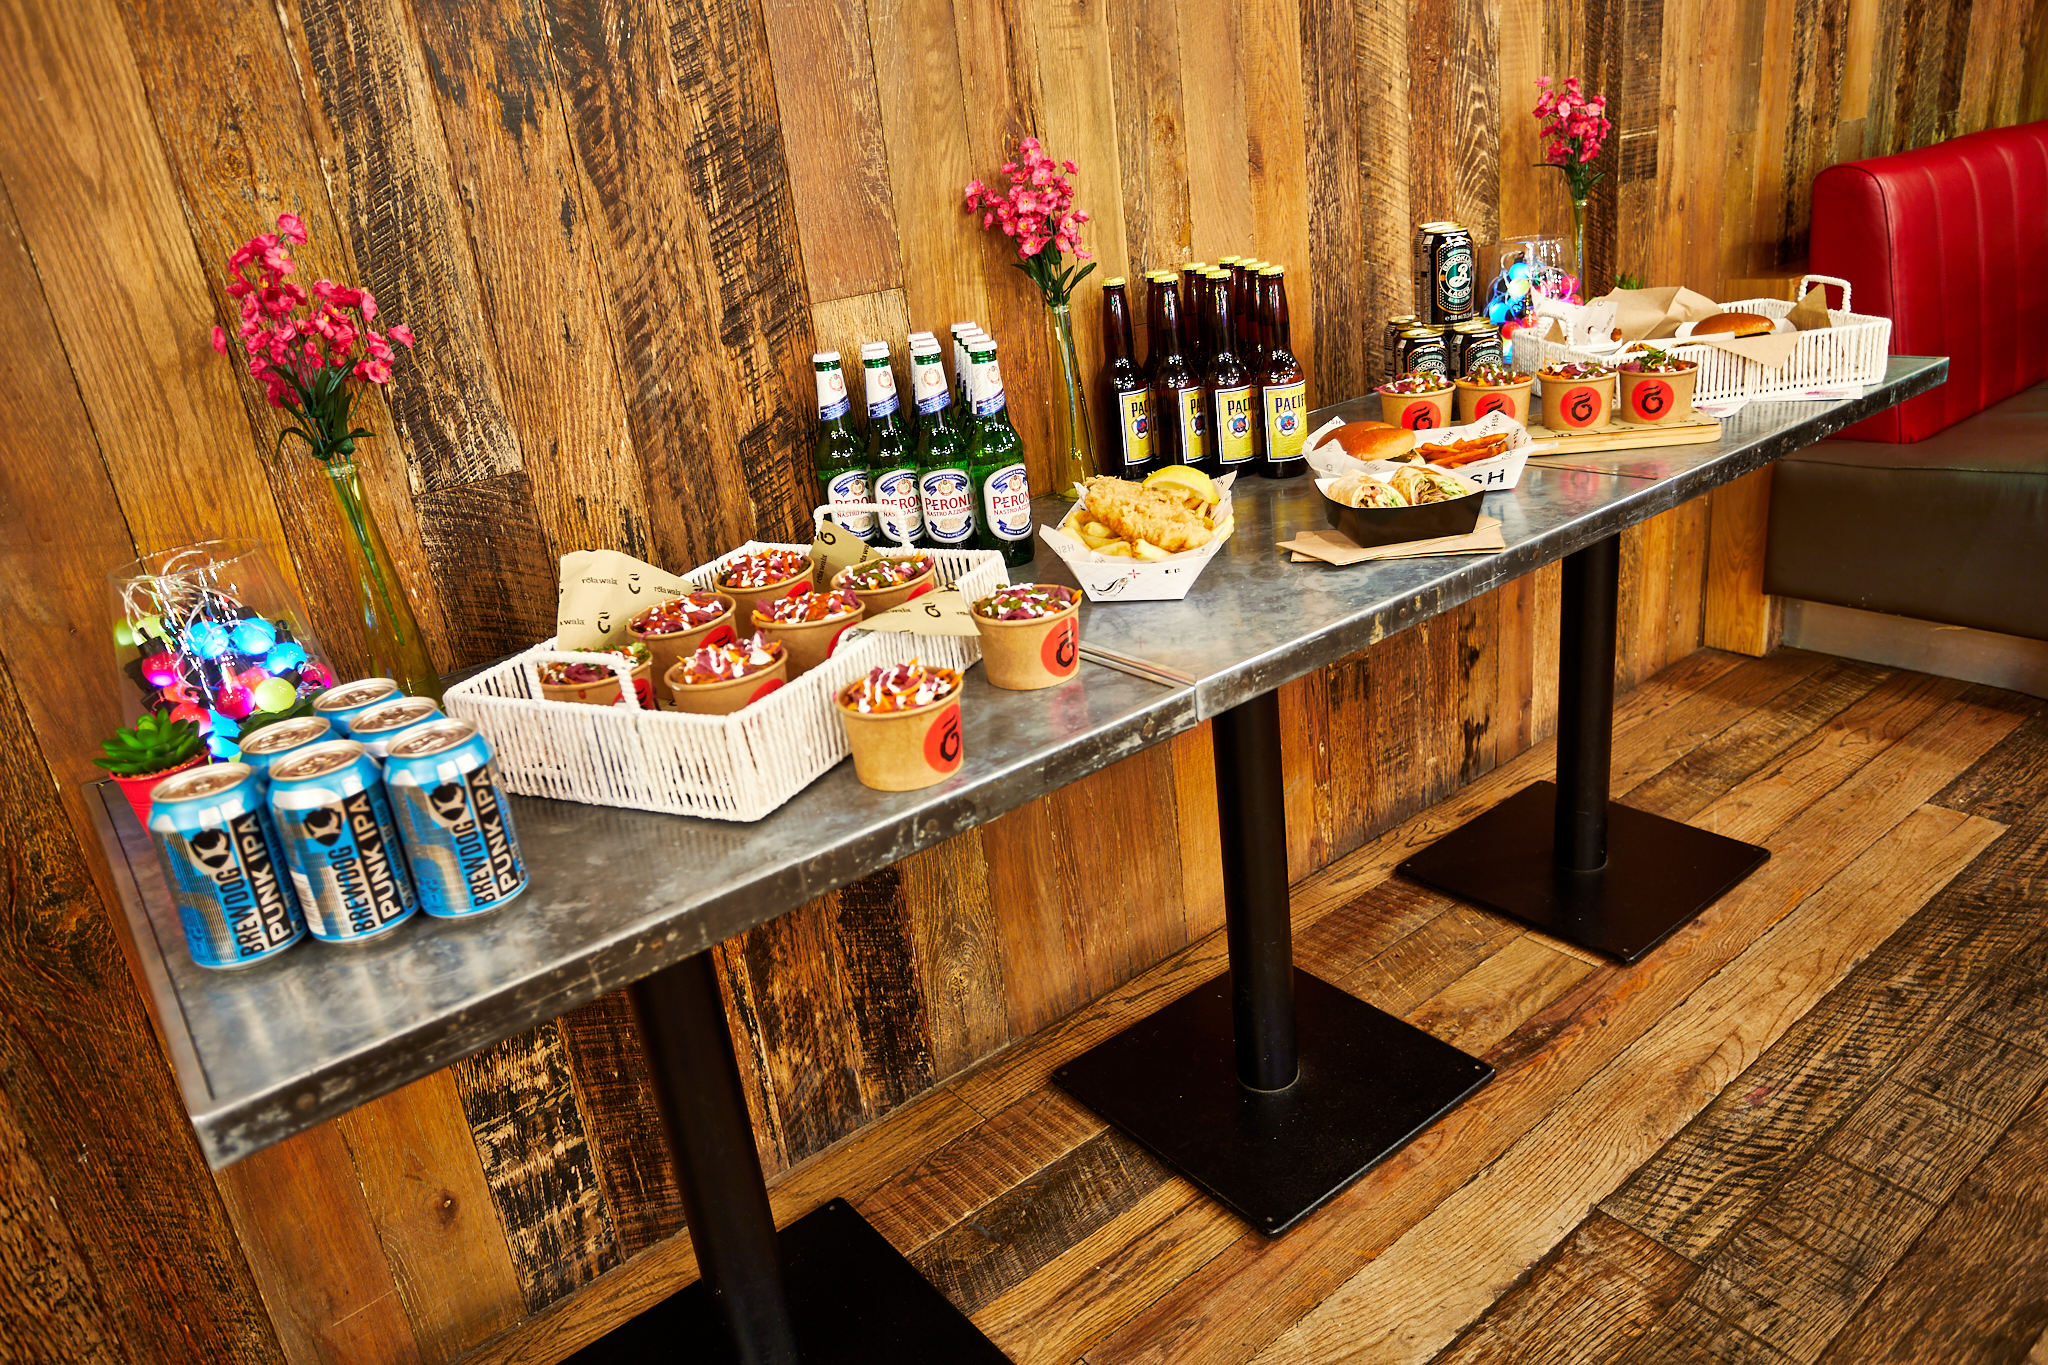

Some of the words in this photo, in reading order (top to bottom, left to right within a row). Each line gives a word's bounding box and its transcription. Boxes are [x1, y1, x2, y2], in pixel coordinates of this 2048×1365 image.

[1416, 360, 1446, 373] ROOKLYN
[1438, 431, 1454, 446] FISH
[992, 491, 1029, 509] PERON
[1470, 469, 1505, 485] SH
[925, 493, 971, 511] PERONI
[993, 507, 1018, 516] NASTRO
[472, 768, 497, 815] IPA
[238, 813, 267, 862] IPA
[349, 794, 378, 841] IPA
[452, 819, 496, 906] BREWDOG
[483, 815, 518, 892] PUNK
[251, 863, 290, 942] PUNK
[328, 845, 376, 932] BREWDOG
[362, 842, 401, 919] PUNK
[215, 866, 265, 957] BREWDOG
